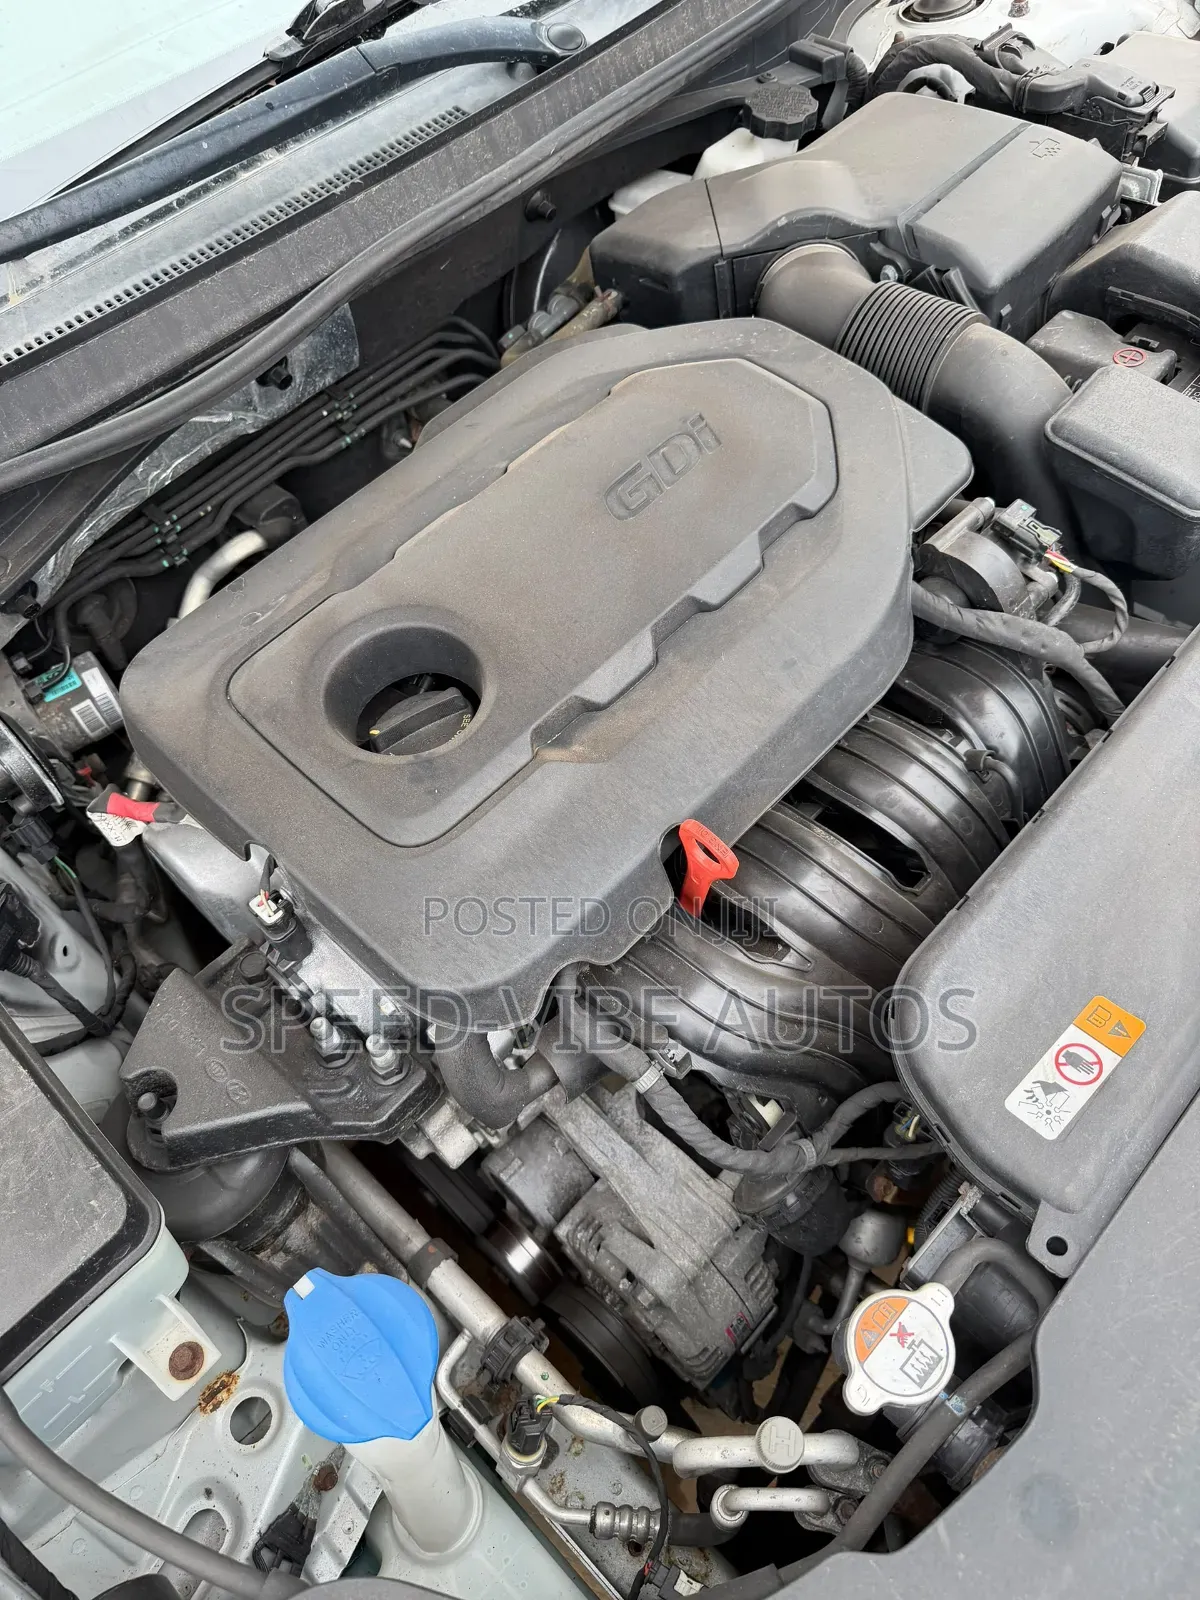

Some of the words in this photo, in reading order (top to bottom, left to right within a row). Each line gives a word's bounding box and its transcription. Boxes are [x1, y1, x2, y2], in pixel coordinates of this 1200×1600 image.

[604, 412, 723, 521] GDi
[460, 714, 472, 728] SEE
[317, 1308, 361, 1349] WASHER
[332, 1327, 361, 1351] ONLY
[769, 1425, 798, 1458] H
